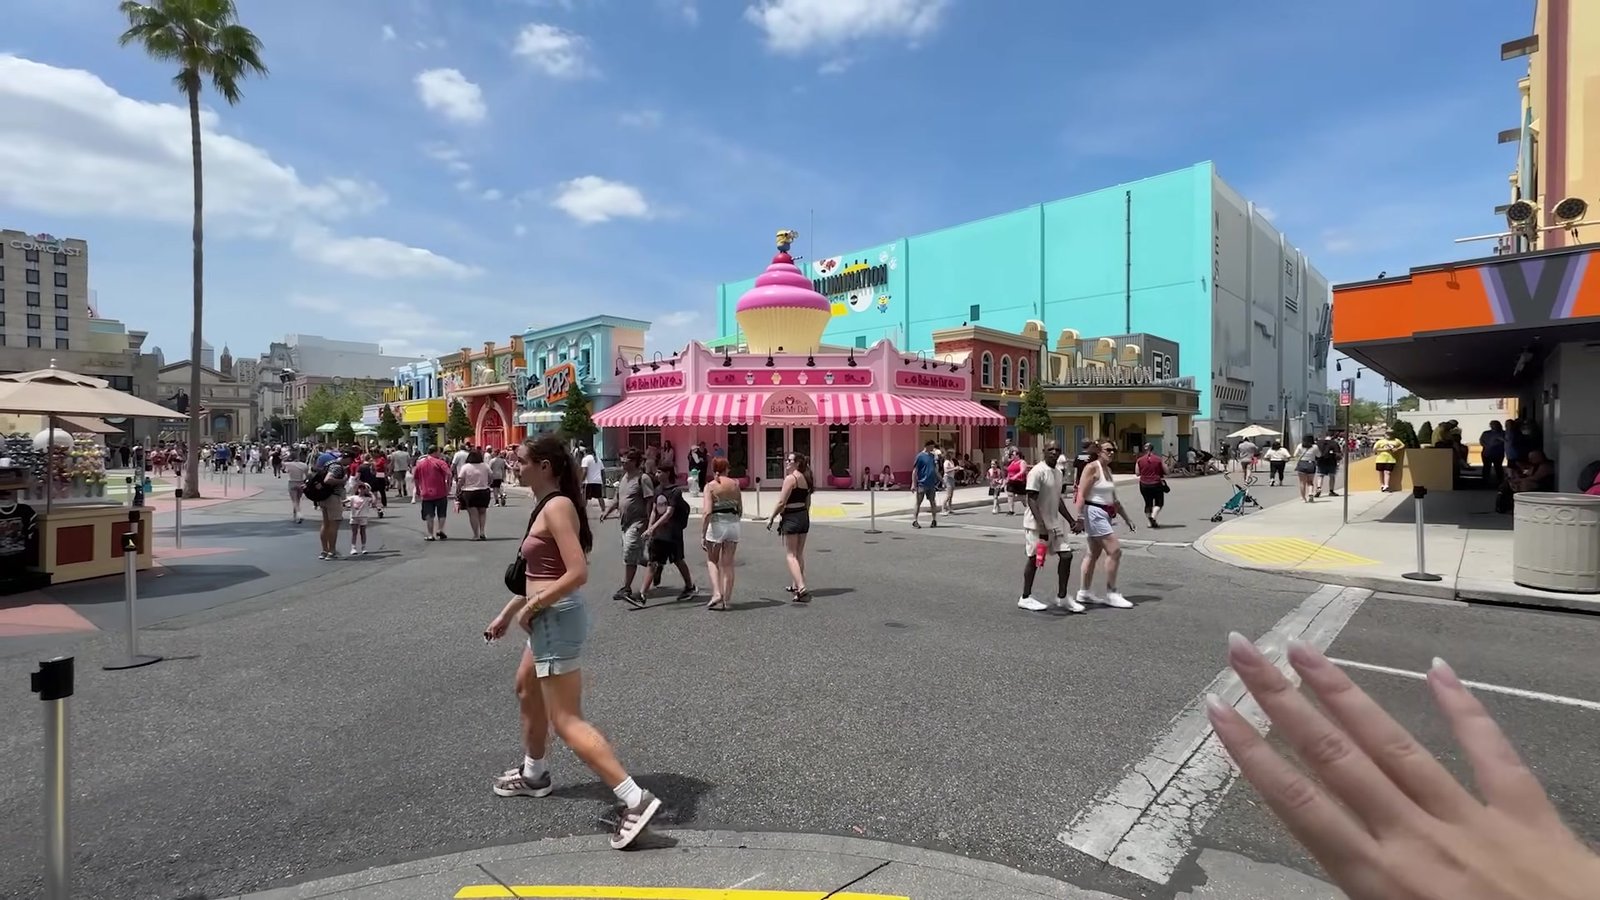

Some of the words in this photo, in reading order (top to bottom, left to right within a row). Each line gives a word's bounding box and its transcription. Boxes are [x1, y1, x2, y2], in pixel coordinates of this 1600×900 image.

[10, 239, 81, 256] COMCAST
[546, 367, 570, 396] POPS
[1067, 363, 1152, 386] ILLUMINATION
